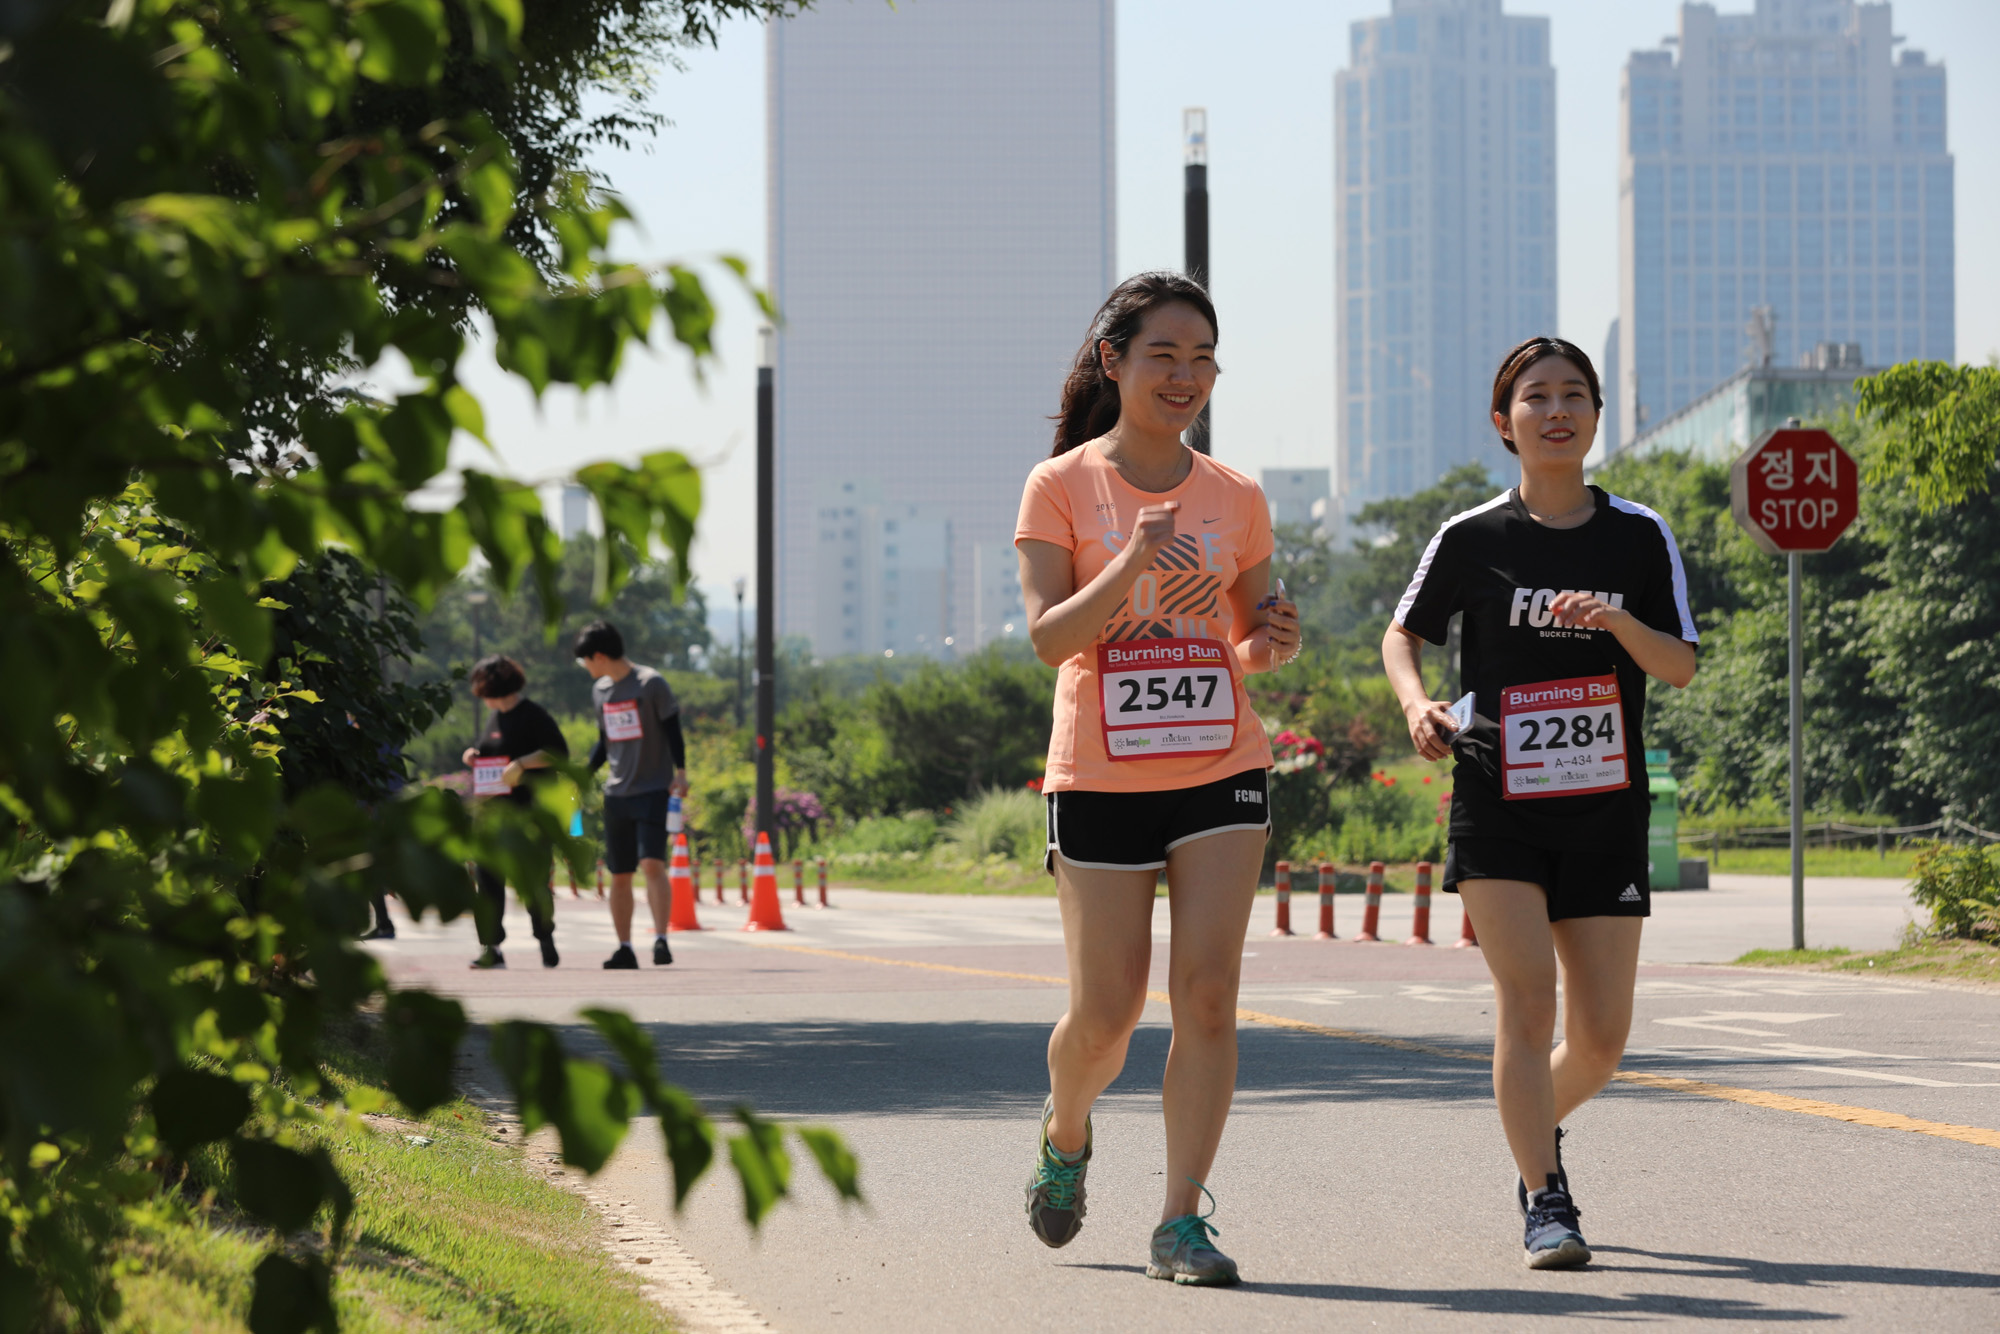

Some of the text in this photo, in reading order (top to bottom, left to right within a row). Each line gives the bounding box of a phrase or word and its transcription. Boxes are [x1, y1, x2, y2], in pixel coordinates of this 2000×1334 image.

[1760, 448, 1838, 490] 정지
[1096, 502, 1115, 511] 2015
[1761, 498, 1838, 529] STOP
[1574, 632, 1592, 640] RUN
[1108, 644, 1221, 662] Burning Run
[1118, 675, 1218, 712] 2547
[1510, 683, 1617, 705] Burning Run
[1519, 712, 1615, 752] 2284
[1555, 754, 1592, 768] A-434
